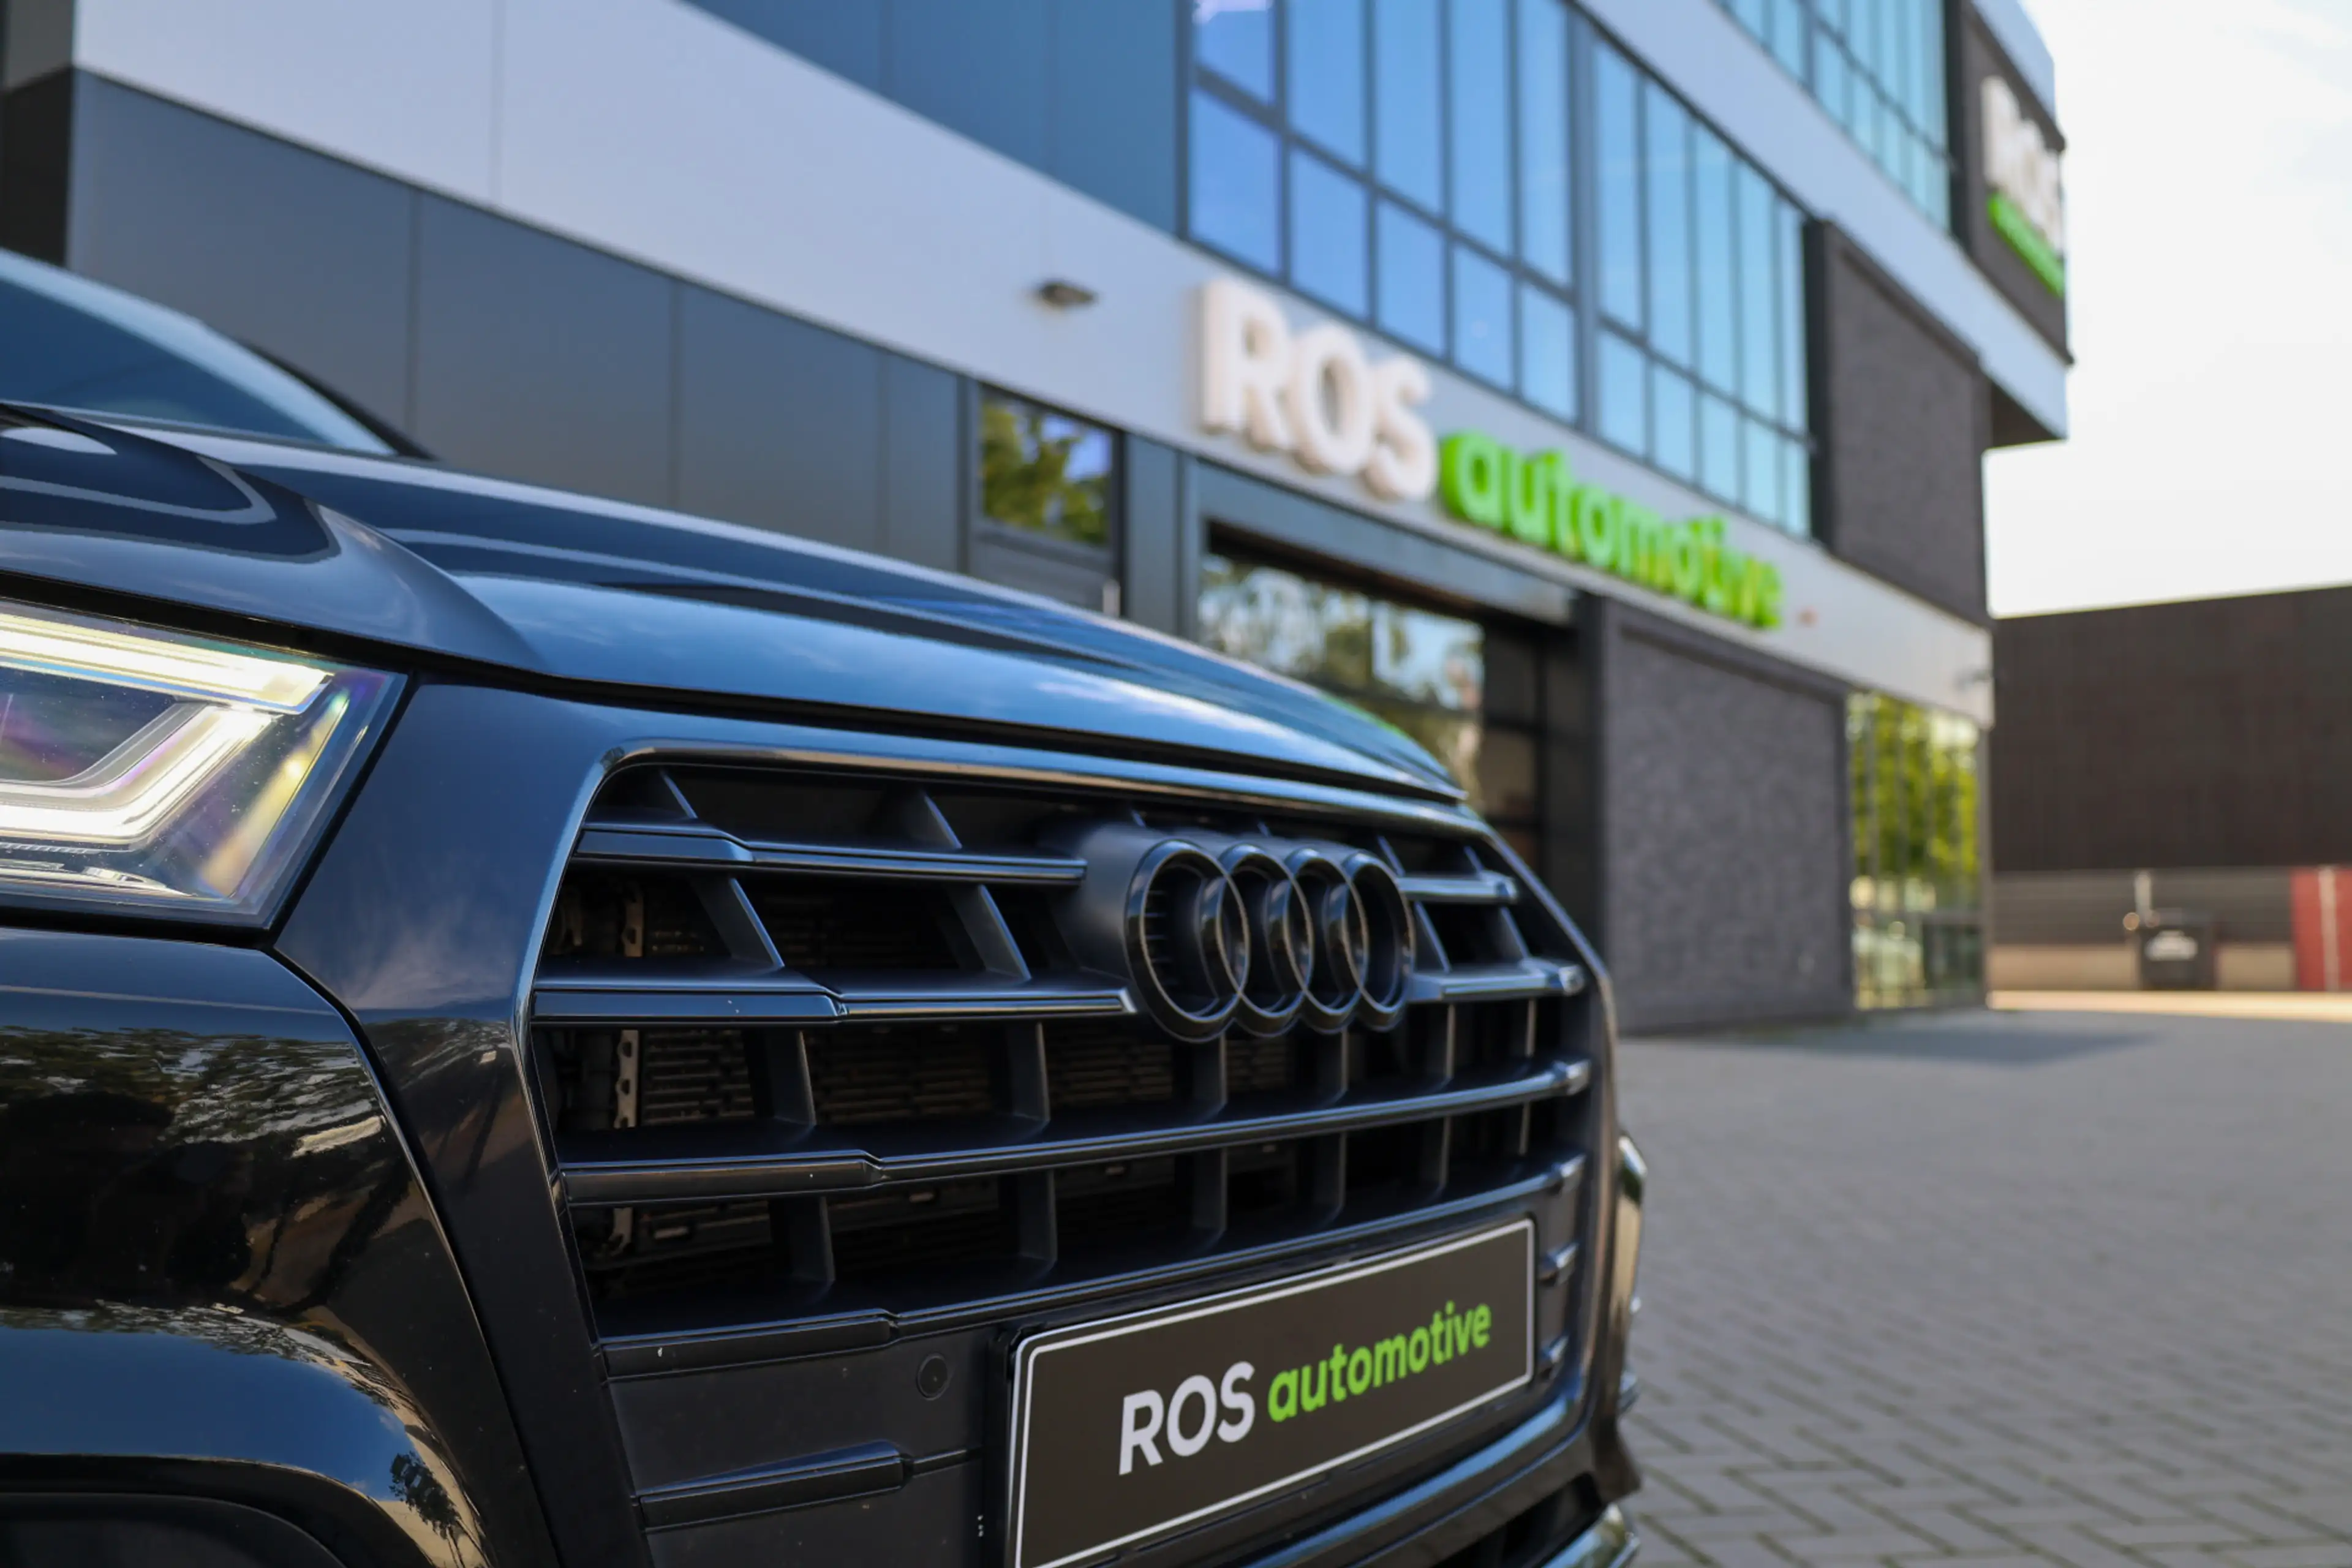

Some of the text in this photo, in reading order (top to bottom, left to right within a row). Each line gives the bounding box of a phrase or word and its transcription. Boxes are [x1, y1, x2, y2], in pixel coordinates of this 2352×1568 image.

[1202, 279, 1781, 630] ROS automotive
[1119, 1300, 1492, 1475] ROS automotive
